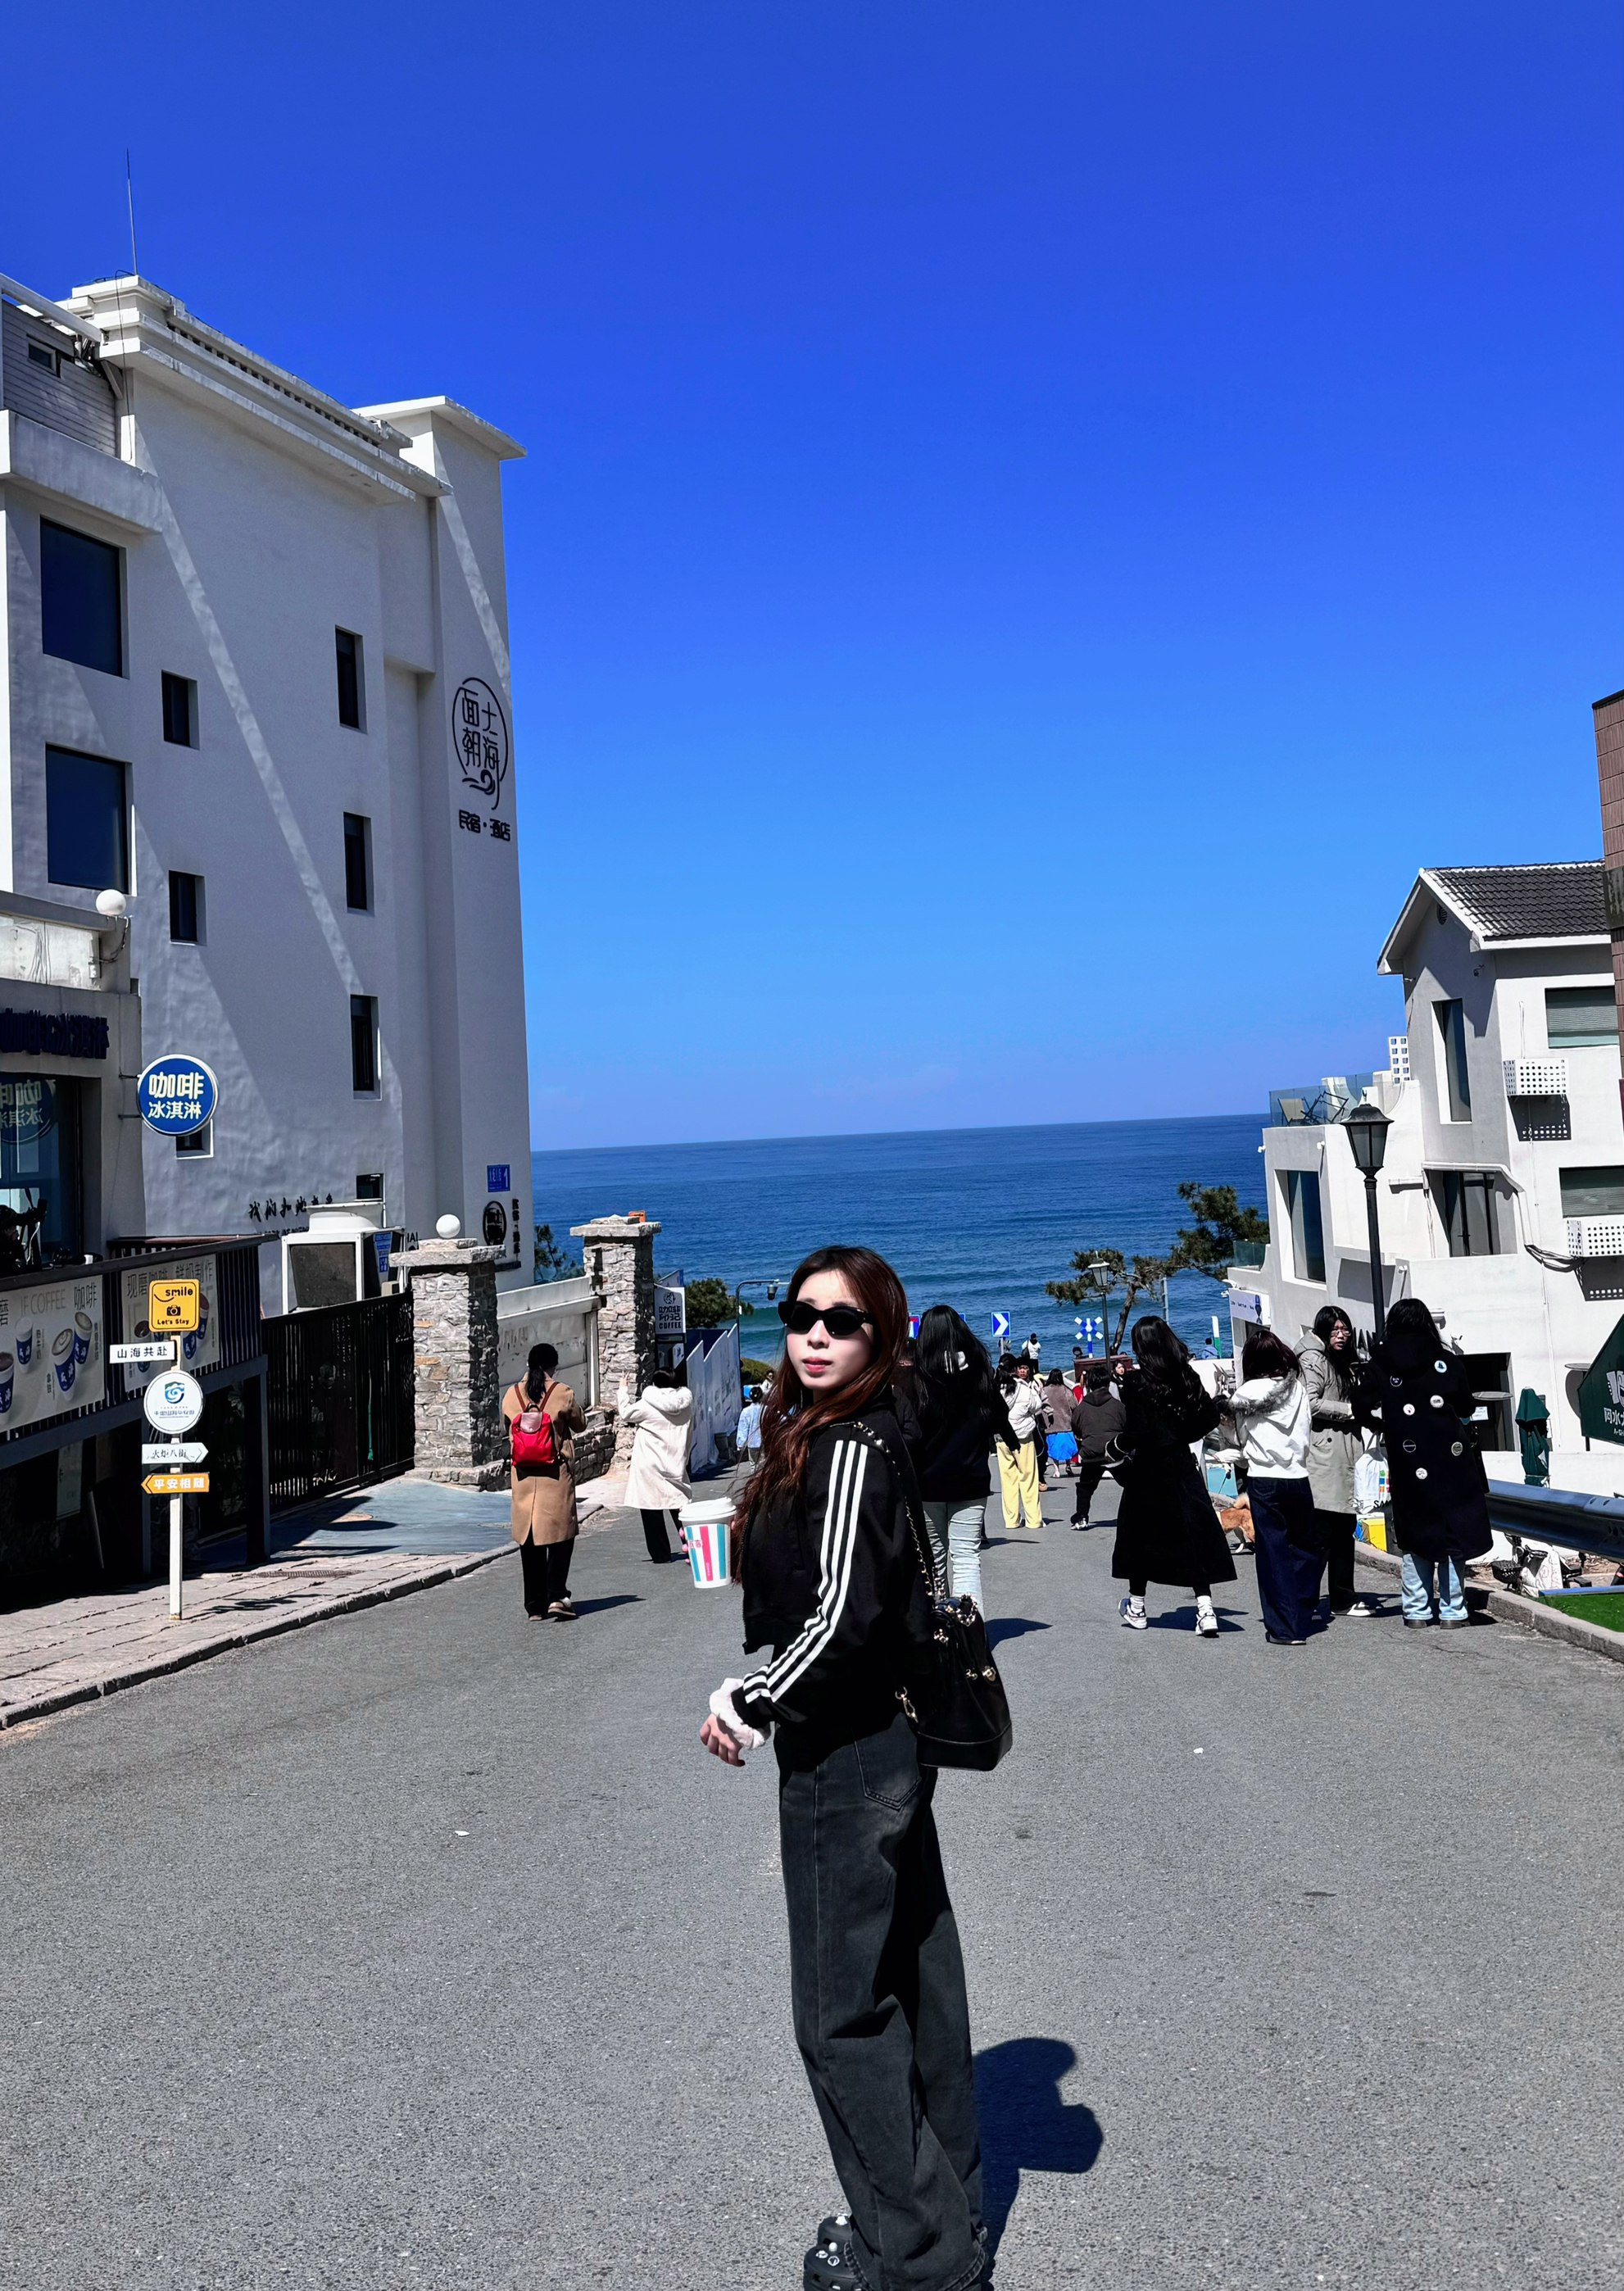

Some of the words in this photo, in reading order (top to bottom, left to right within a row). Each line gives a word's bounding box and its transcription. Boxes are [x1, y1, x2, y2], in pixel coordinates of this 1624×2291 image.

[148, 1071, 205, 1100] 咖啡
[147, 1100, 202, 1119] 冰淇淋
[31, 1289, 66, 1315] COFFEE
[75, 1282, 98, 1310] 咖啡
[165, 1286, 193, 1296] smile
[117, 1345, 167, 1359] 山海共赴
